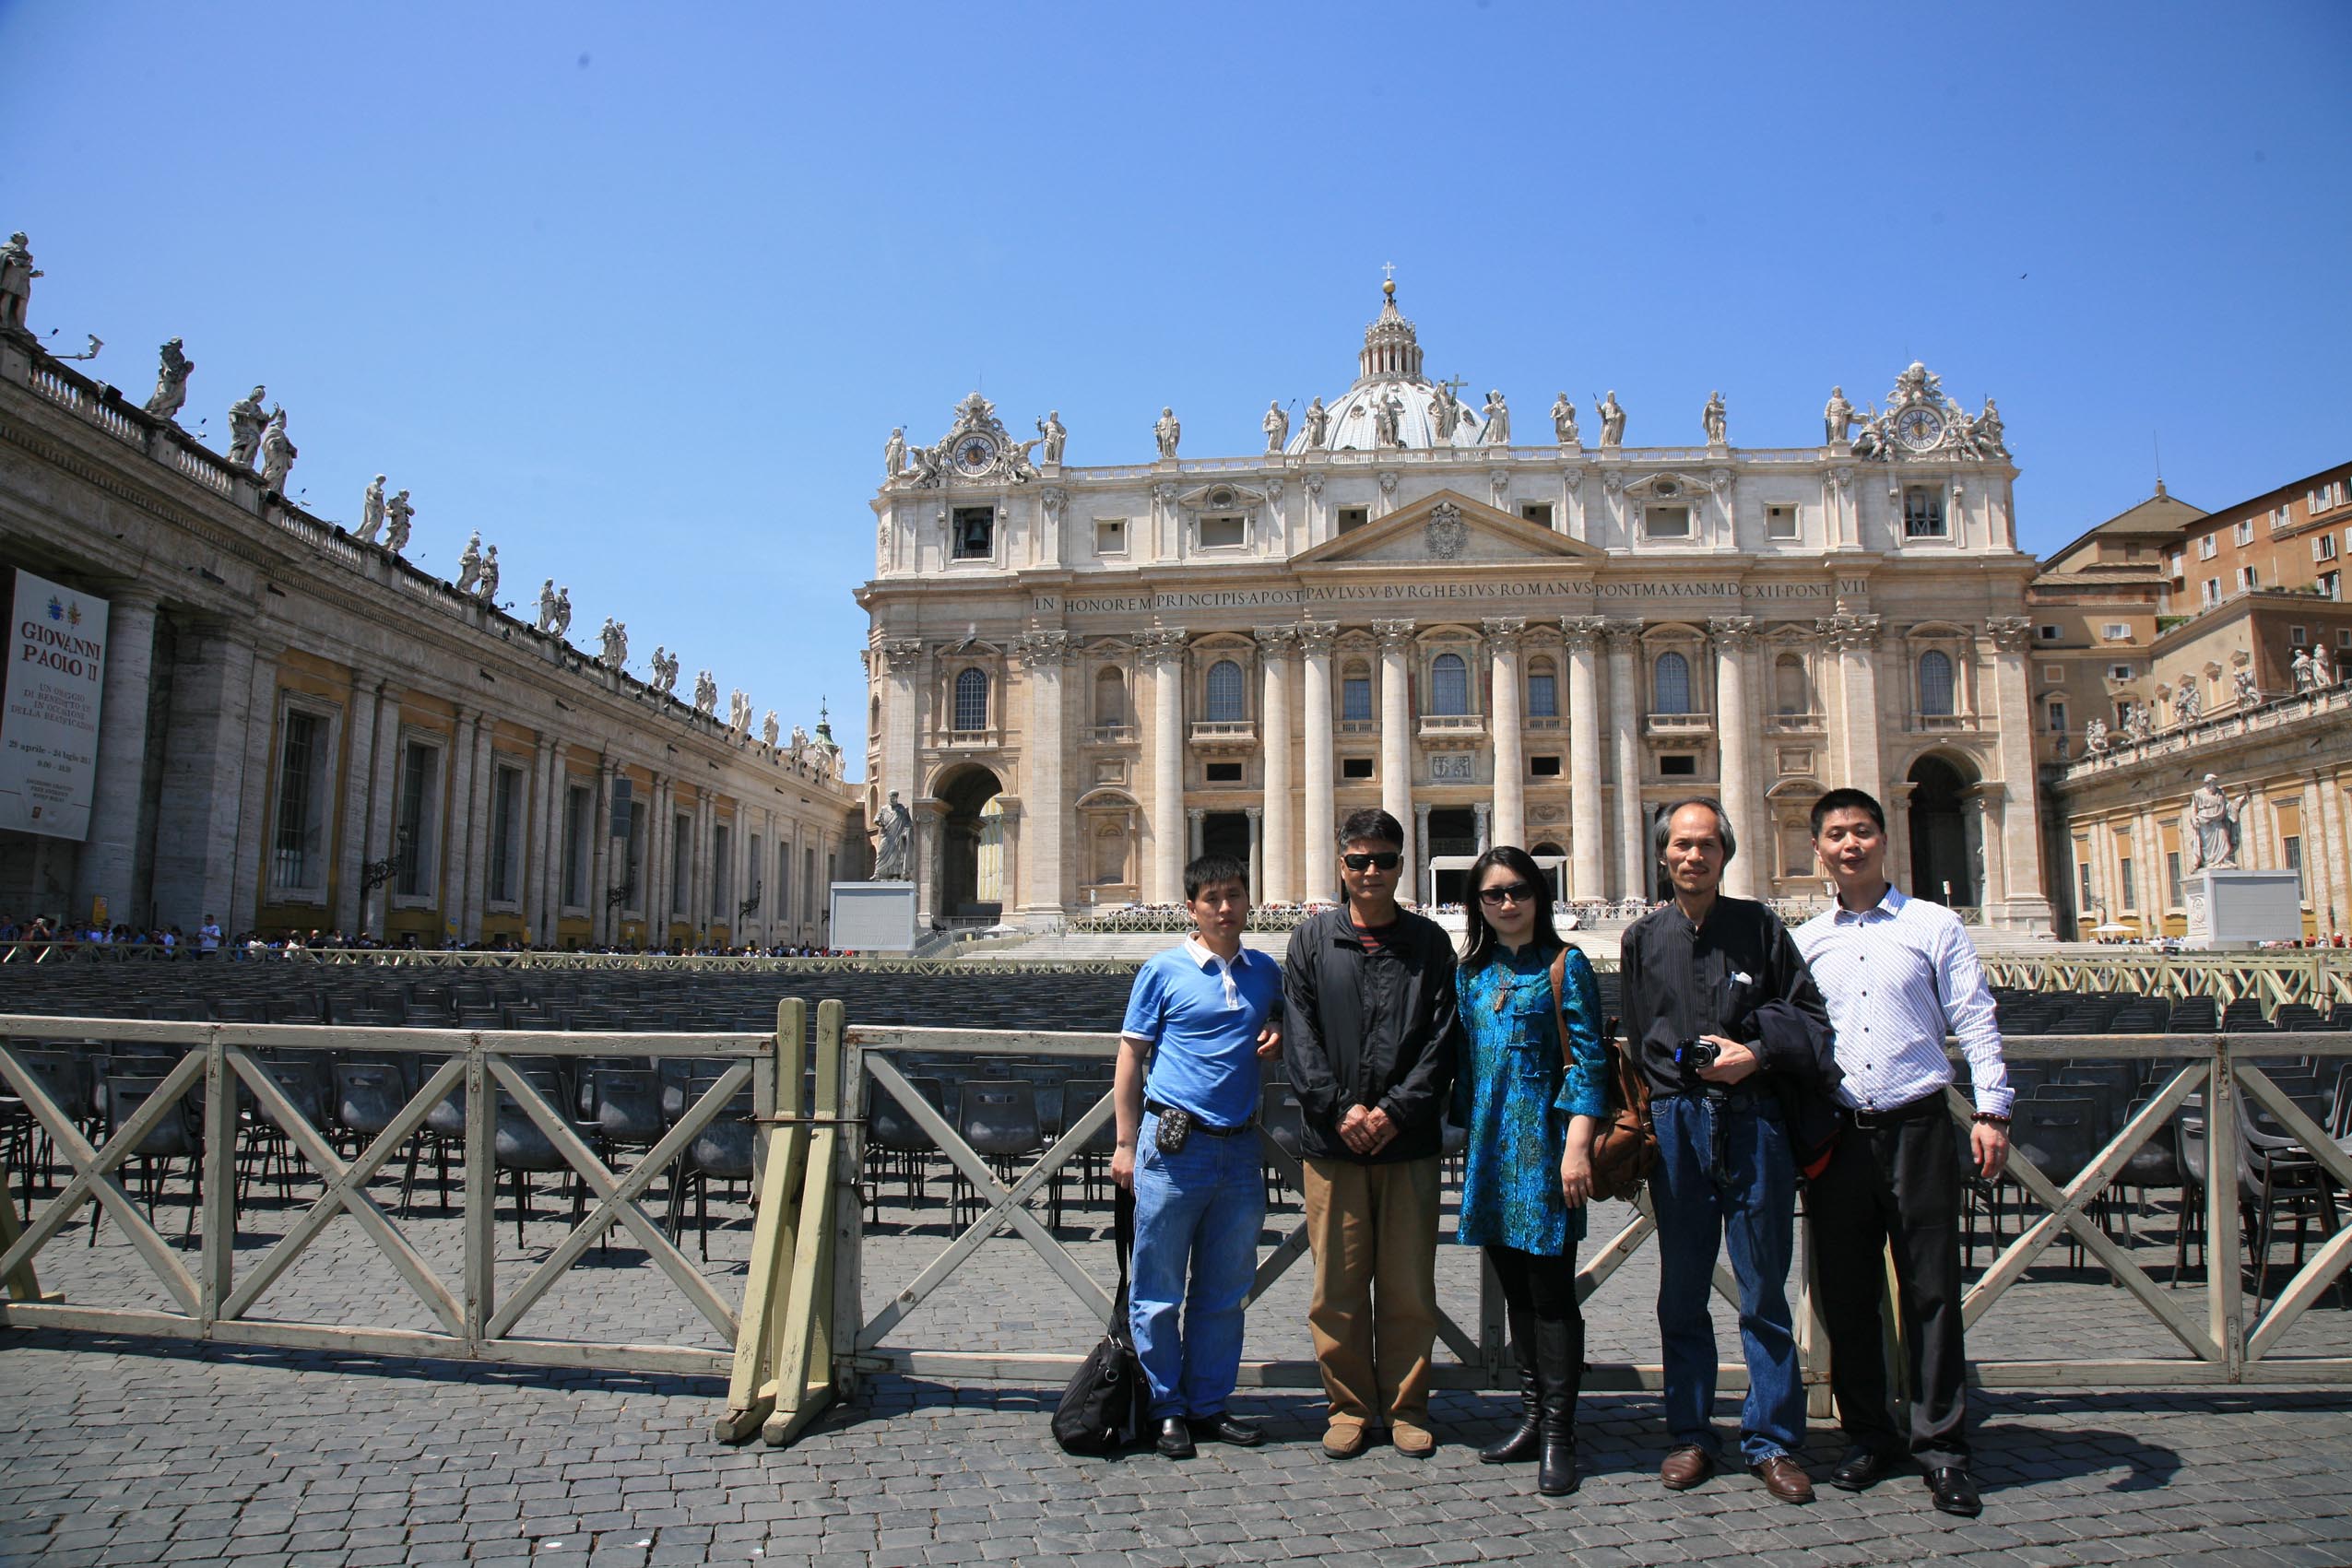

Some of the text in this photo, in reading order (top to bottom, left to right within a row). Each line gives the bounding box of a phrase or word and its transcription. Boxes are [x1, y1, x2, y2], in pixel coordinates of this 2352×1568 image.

[1034, 596, 1055, 610] IN
[1064, 596, 1152, 612] HONOREM
[1840, 580, 1865, 593] VII
[21, 620, 101, 662] GIOVANNI
[88, 663, 98, 682] II
[19, 743, 46, 754] aprile
